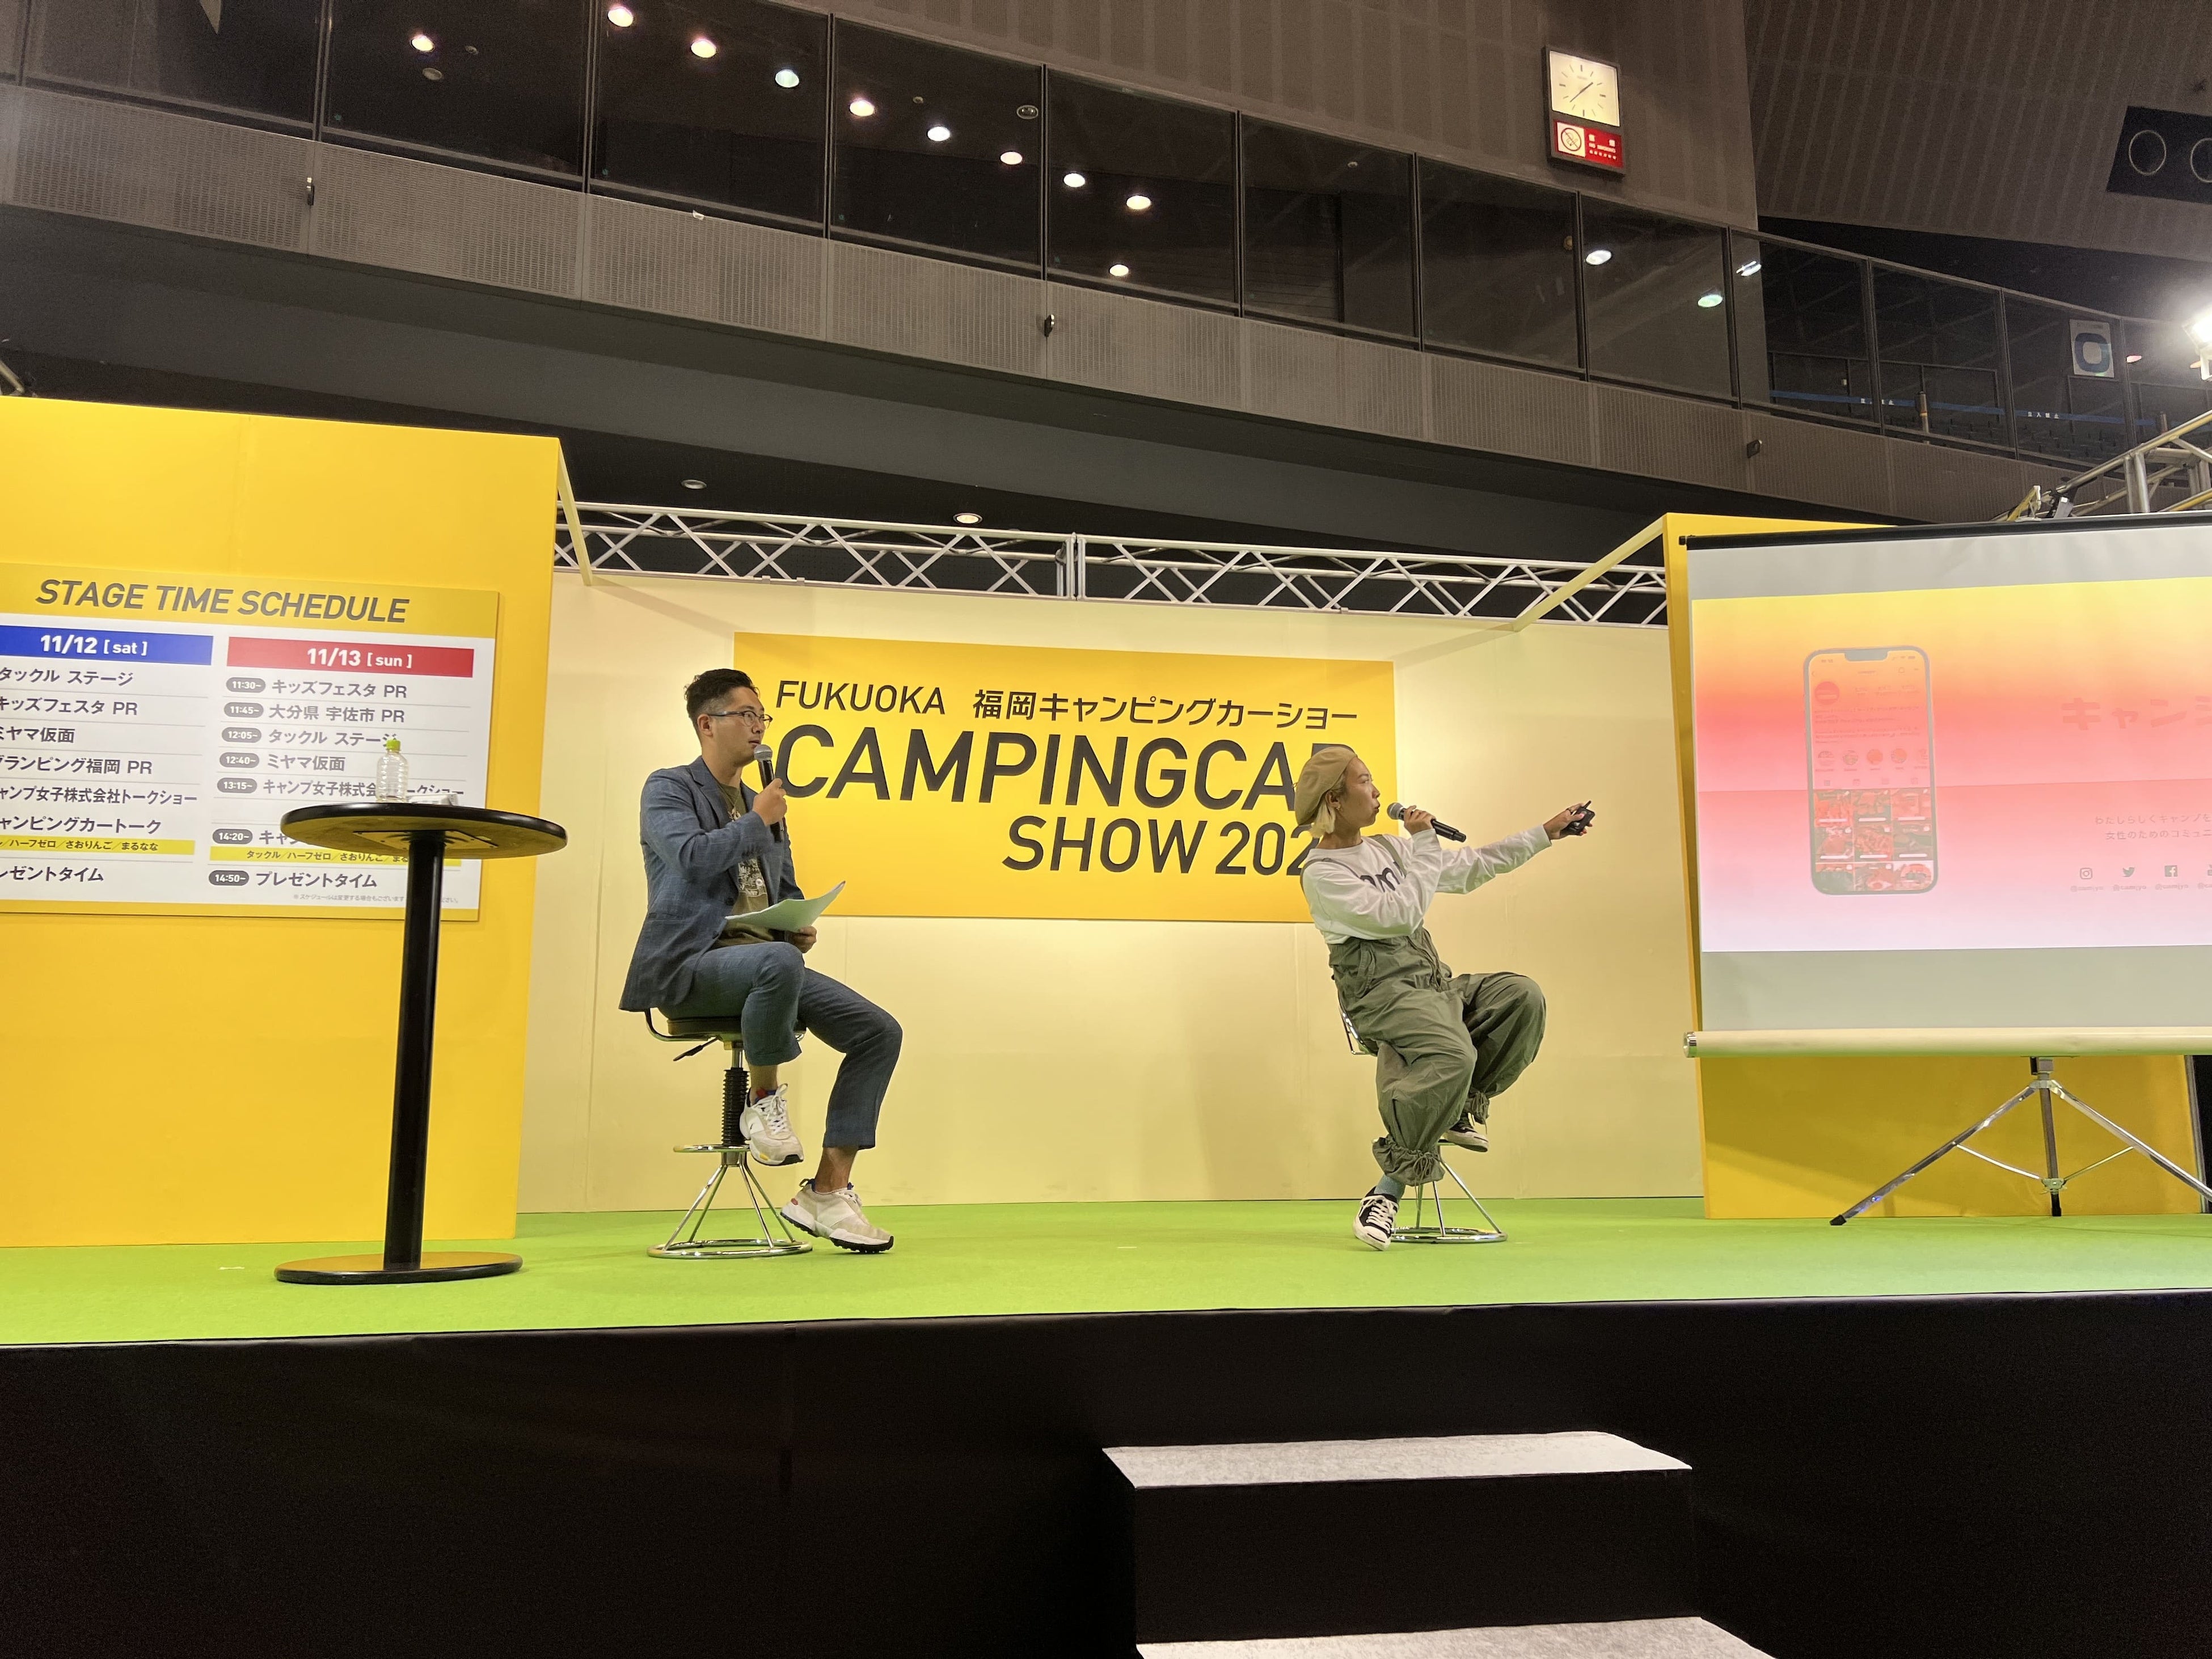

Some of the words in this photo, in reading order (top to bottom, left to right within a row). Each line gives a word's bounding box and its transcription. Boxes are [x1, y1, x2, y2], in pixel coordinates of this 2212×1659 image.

[36, 579, 149, 610] STAGE
[155, 584, 233, 613] TIME
[238, 590, 410, 623] SCHEDULE
[40, 634, 98, 655] 11/12
[307, 648, 361, 666] 11/13
[67, 670, 133, 686] ステージ
[272, 679, 377, 697] キッズフェスタ
[383, 685, 407, 698] PR
[113, 701, 138, 715] PR
[268, 704, 319, 720] 大分県
[326, 706, 375, 723] 宇佐市
[381, 709, 404, 723] PR
[776, 679, 946, 715] FUKUOKA
[973, 689, 1358, 730] 福岡キャンピングカーショー
[268, 728, 327, 745] タックル
[0, 755, 120, 774] ランピング福岡
[127, 761, 153, 775] PR
[267, 753, 345, 771] ミヤマ仮面
[776, 725, 1358, 811] CAMPINGCA
[259, 830, 298, 846] キャ
[1002, 816, 1208, 876] SHOW
[256, 871, 377, 888] プレゼントタイム
